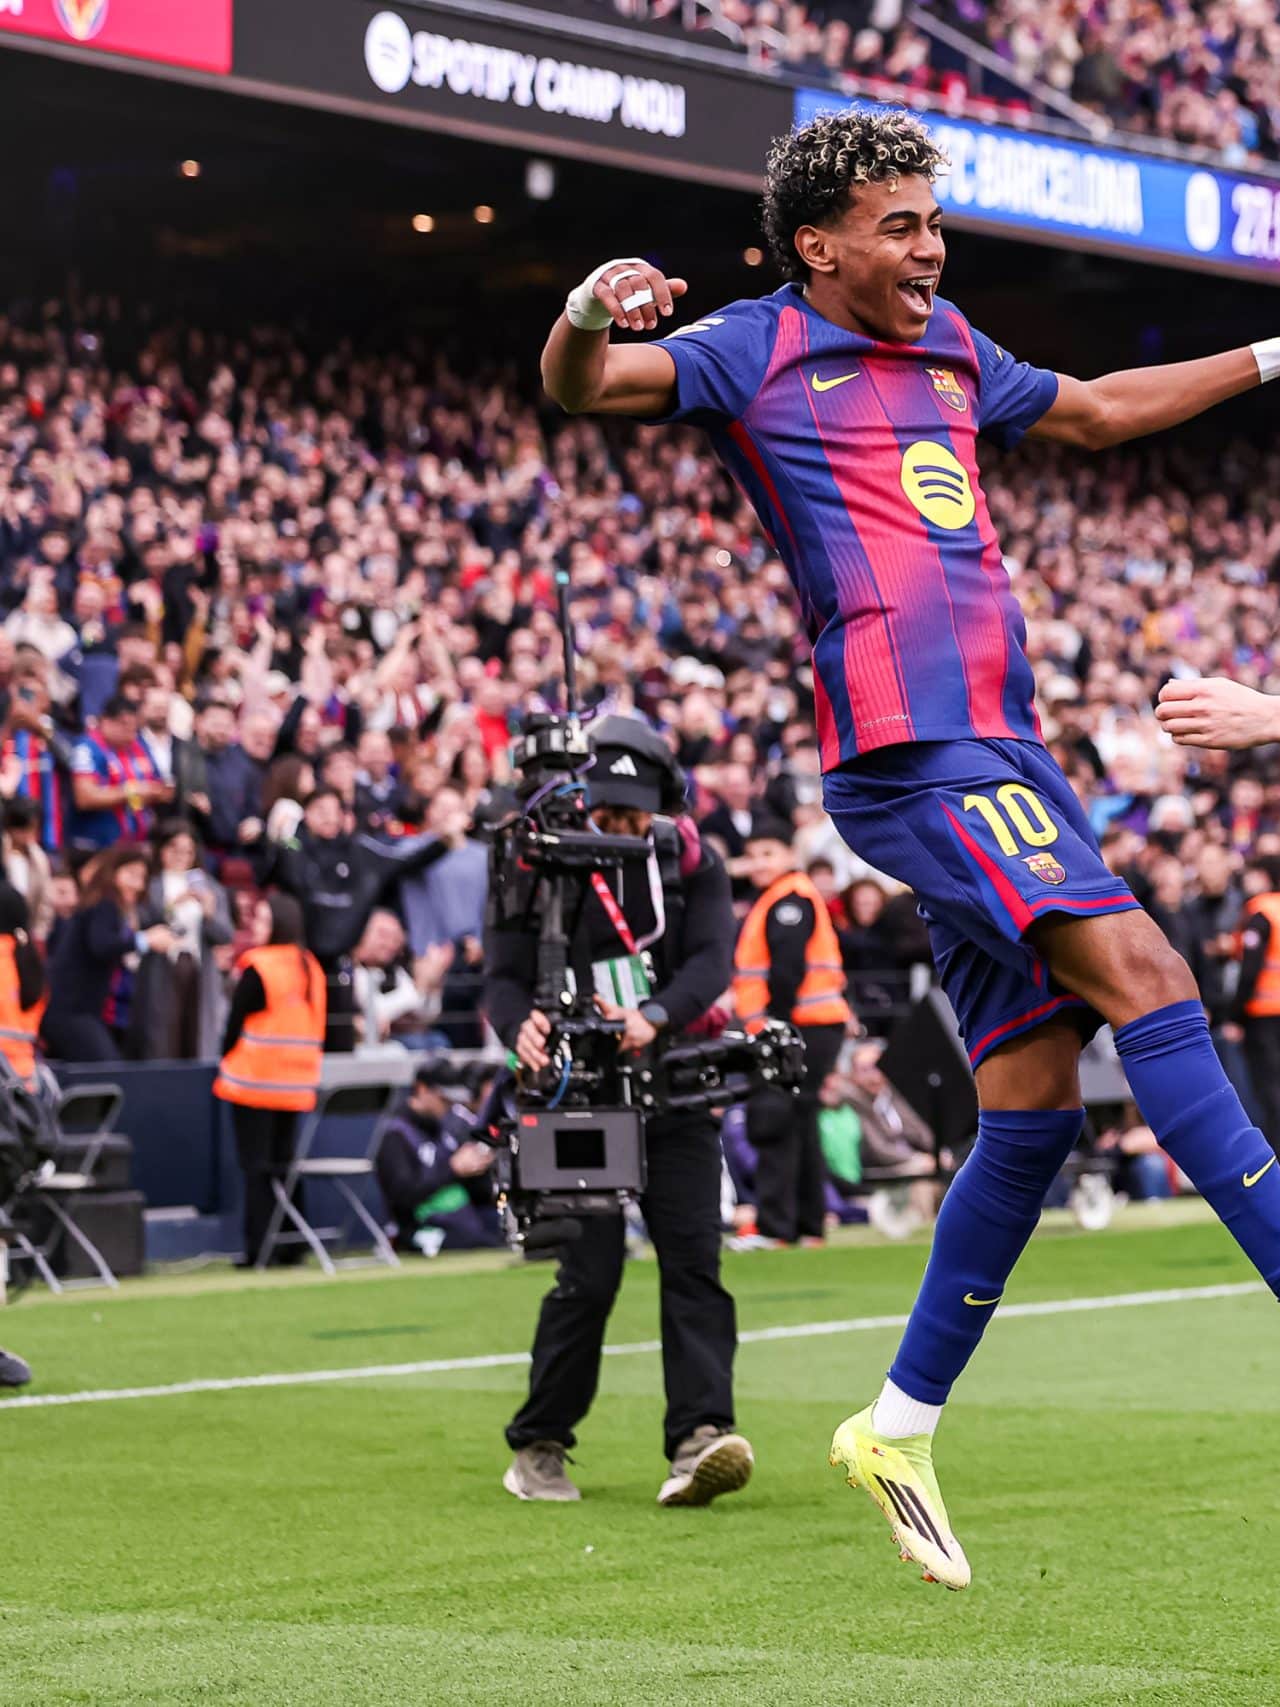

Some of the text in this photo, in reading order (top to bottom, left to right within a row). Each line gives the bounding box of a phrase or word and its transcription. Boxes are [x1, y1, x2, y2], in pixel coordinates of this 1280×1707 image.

[411, 30, 686, 138] SPOTIFY CAMP NOU
[975, 132, 1144, 236] BARCELONA
[1184, 171, 1220, 252] 0
[962, 783, 1059, 858] 10
